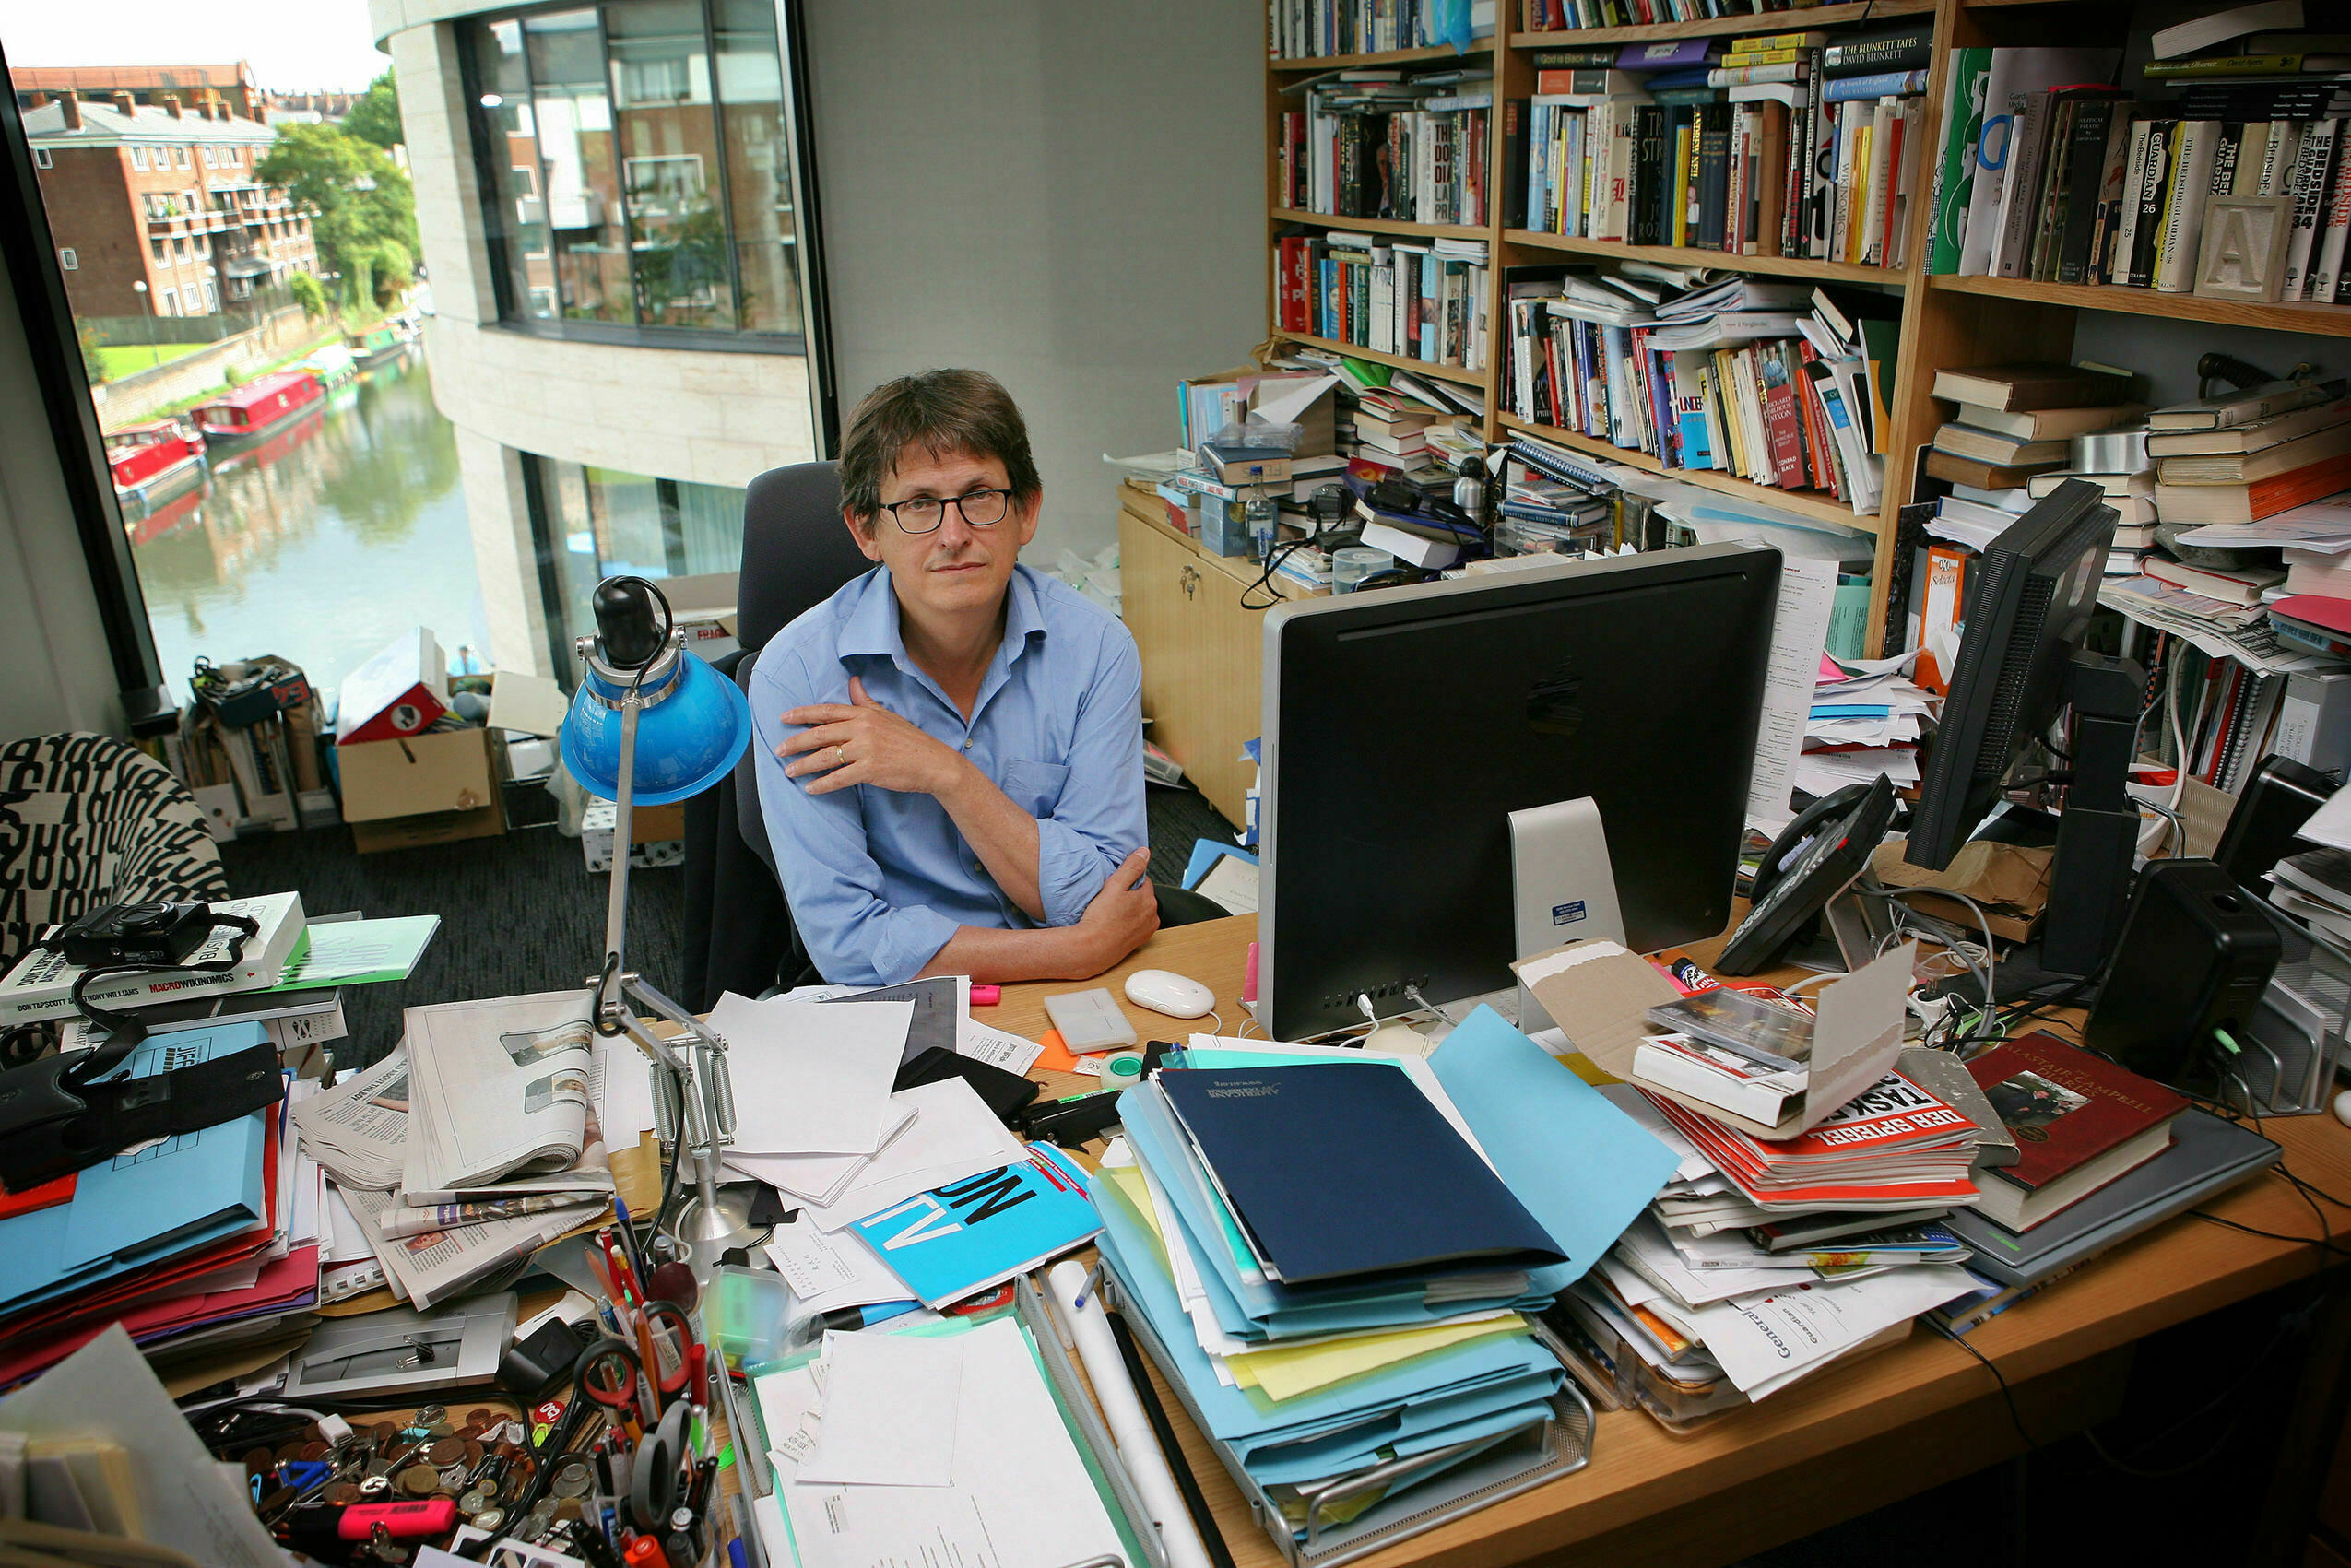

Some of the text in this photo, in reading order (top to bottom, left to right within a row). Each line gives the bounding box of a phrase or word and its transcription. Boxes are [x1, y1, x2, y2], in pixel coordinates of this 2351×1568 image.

[1844, 36, 1917, 55] THE BLUNKETT TAPES
[1844, 49, 1902, 65] DAVID BLUNKETT
[1690, 112, 1702, 179] ANDREW NEIL
[2133, 147, 2144, 175] Bedside
[2138, 133, 2146, 147] The
[2184, 137, 2193, 159] THE
[2143, 134, 2162, 213] GUARDIAN 26
[2176, 161, 2189, 205] BEDSIDE
[2219, 143, 2238, 196] THE BED
[2259, 140, 2279, 190] BEDSIDE
[2306, 150, 2329, 215] BEDSIDE
[1727, 169, 1738, 233] SHAWCROSS
[1837, 162, 1849, 236] WIKINOMICS
[2124, 228, 2132, 238] 25
[2168, 206, 2182, 253] GUARDIAN
[2206, 208, 2262, 287] A
[1770, 409, 1792, 422] NIXON
[1778, 456, 1796, 473] CONRAD BLACK
[18, 1003, 32, 1012] DON
[33, 998, 66, 1010] TAPSCOTT
[81, 993, 105, 1005] THONY
[106, 987, 139, 999] WILLIAMS
[149, 973, 234, 994] MACROWIKINOMICS
[2004, 1044, 2154, 1114] ALASTAIR CAMPBELL
[2036, 1067, 2100, 1098] DIARIES
[1808, 1109, 1967, 1146] DER SPIEGEL
[860, 1193, 963, 1252] TV
[1742, 1311, 1791, 1359] General
[1781, 1308, 1818, 1345] Guardian
